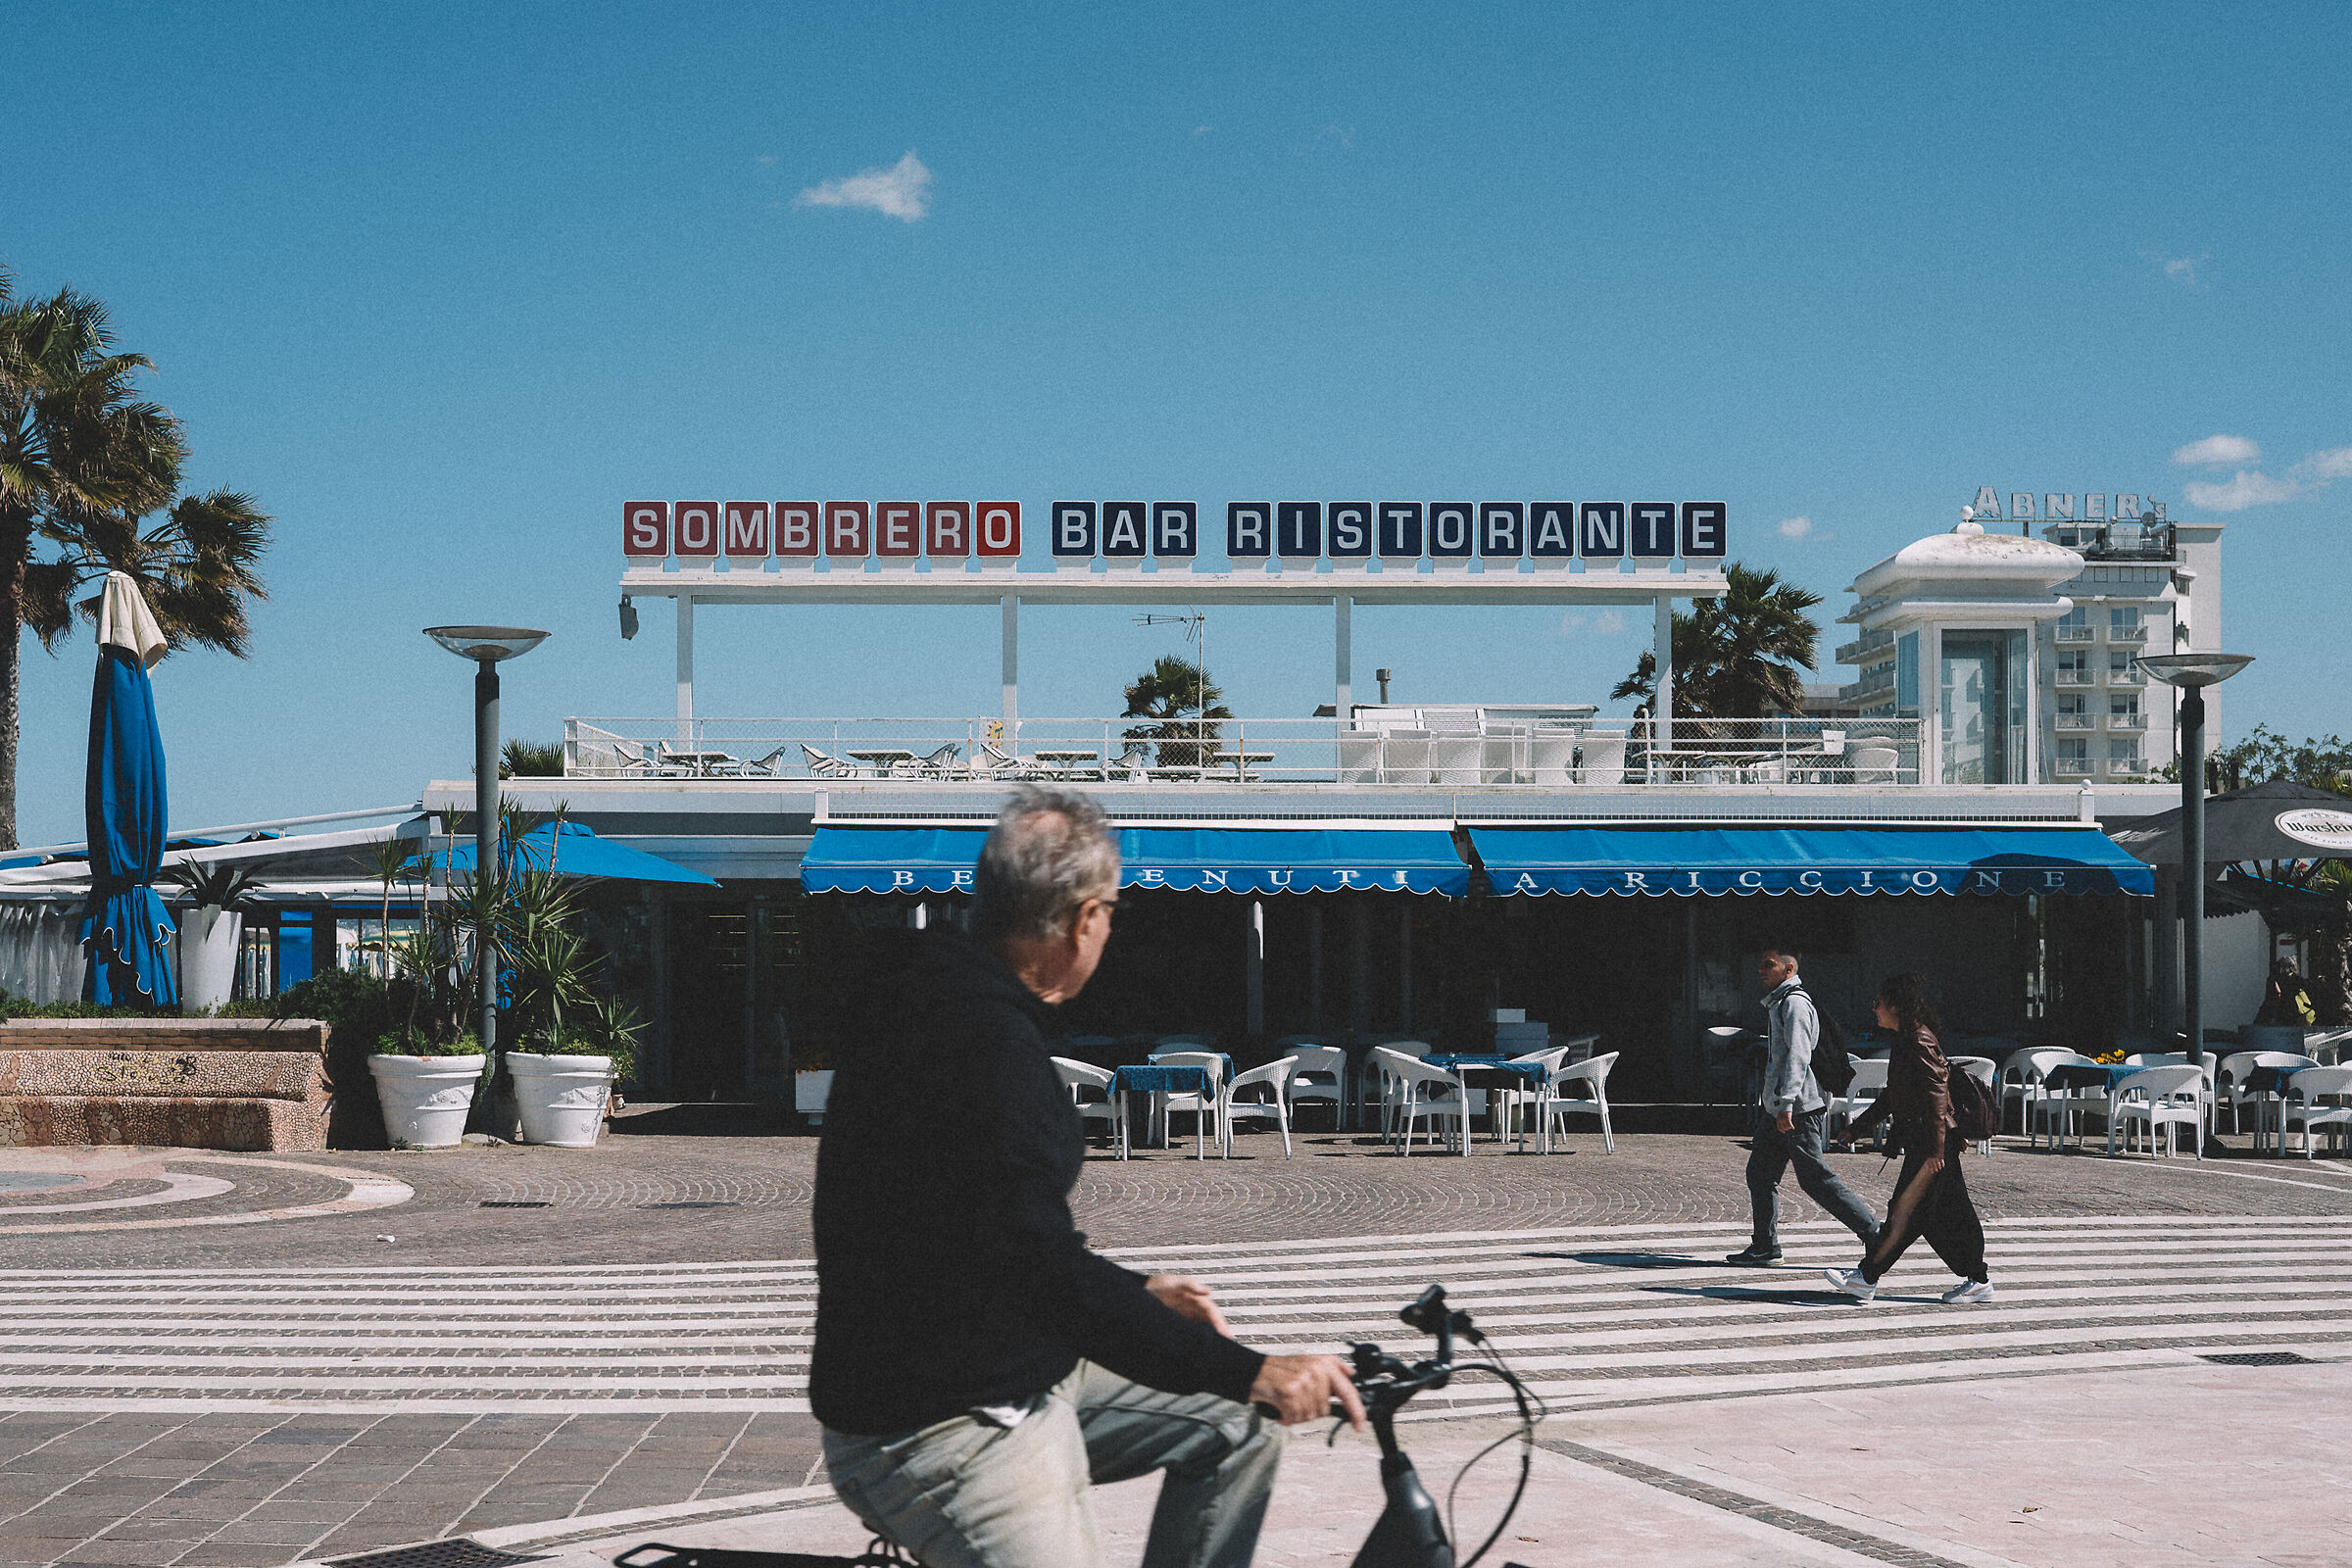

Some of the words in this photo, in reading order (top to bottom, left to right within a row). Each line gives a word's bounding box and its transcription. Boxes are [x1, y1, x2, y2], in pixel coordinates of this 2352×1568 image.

[632, 509, 1012, 549] SOMBRERO
[1061, 510, 1188, 549] BAR
[1237, 510, 1715, 549] RISTORANTE
[892, 869, 1408, 887] BEENUTI
[1513, 871, 1539, 888] A
[1624, 870, 2066, 889] RICCIONE
